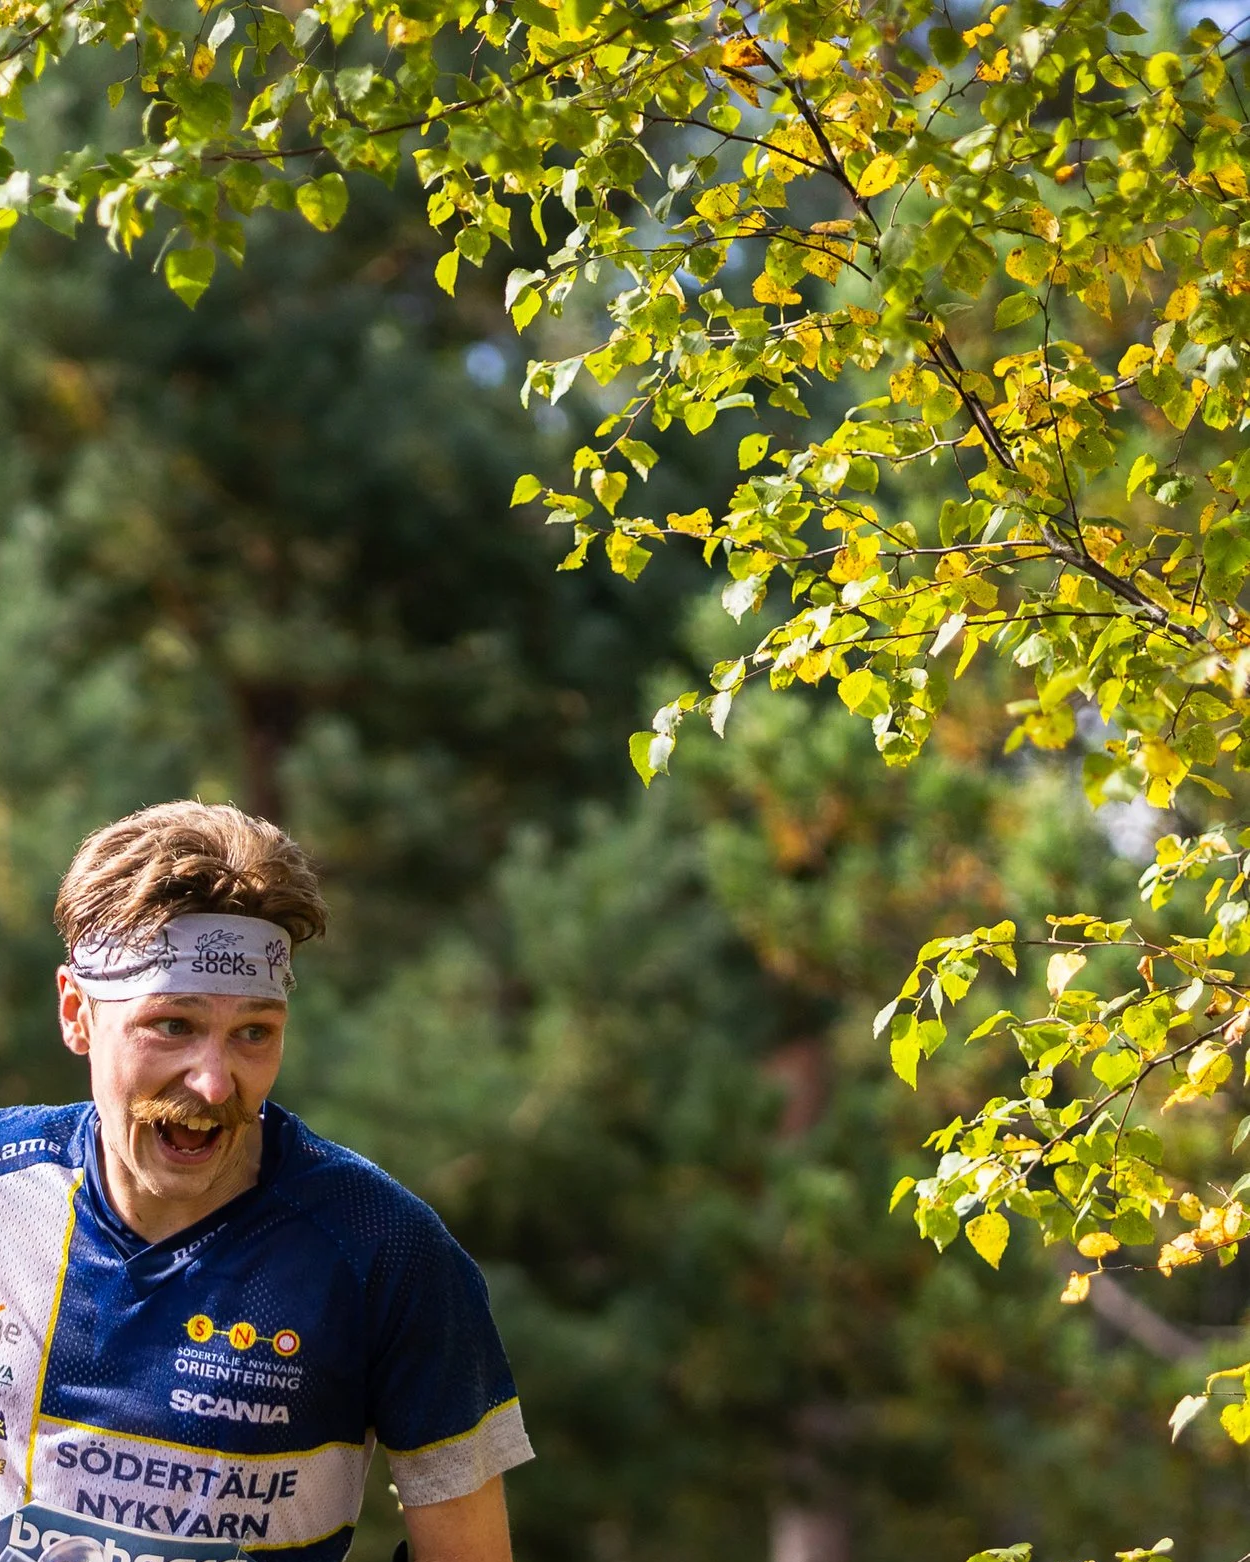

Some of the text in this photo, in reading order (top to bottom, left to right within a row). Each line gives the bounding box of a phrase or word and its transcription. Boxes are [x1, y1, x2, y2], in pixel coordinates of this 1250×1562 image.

[191, 961, 257, 976] SOCKS
[205, 951, 246, 963] OAK
[175, 1358, 300, 1390] ORIENTERING
[169, 1388, 290, 1424] SCANIA
[57, 1440, 298, 1504] SÖDERTÄLJE
[76, 1489, 269, 1538] NYKVARN
